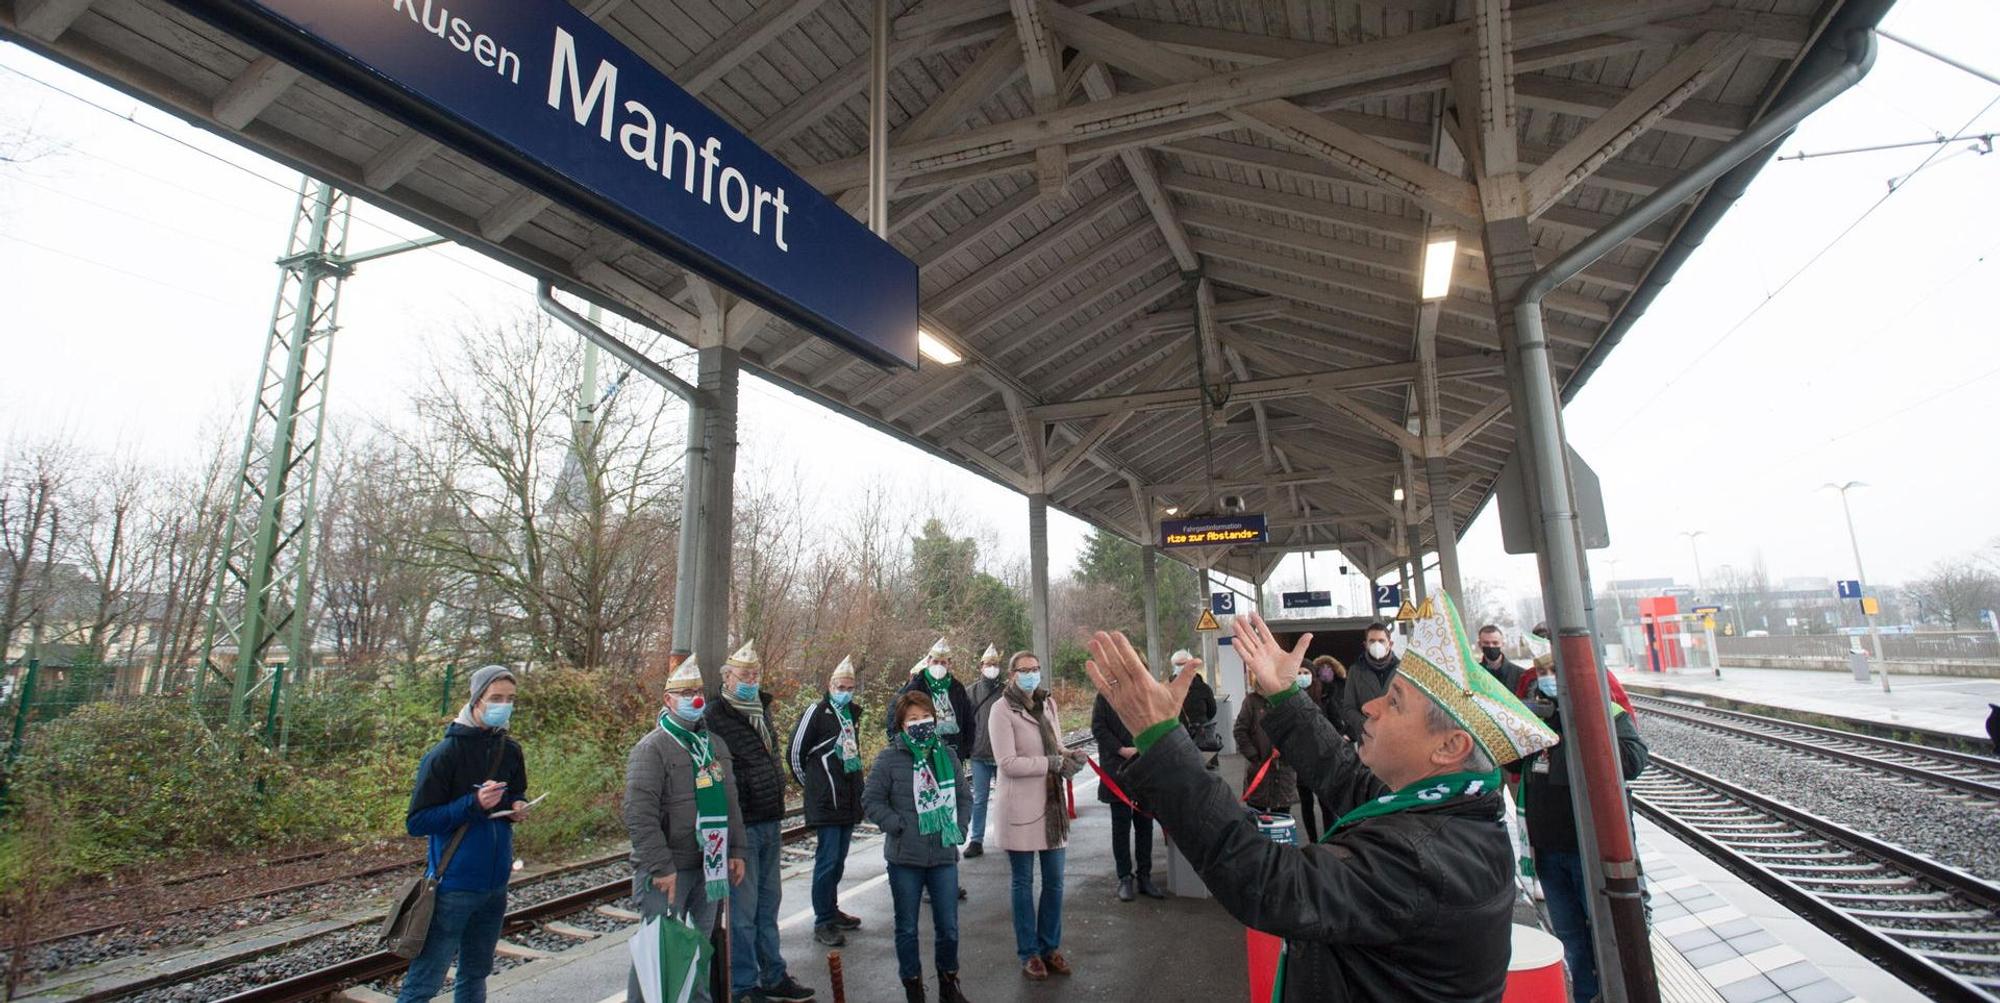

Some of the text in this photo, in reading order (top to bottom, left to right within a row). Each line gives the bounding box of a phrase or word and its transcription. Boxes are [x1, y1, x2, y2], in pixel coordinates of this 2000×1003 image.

[547, 26, 790, 253] Manfort
[1188, 533, 1206, 543] zur
[1206, 529, 1259, 541] Abstands-
[1377, 585, 1391, 603] 2
[1840, 581, 1850, 595] 1
[1220, 593, 1232, 610] 3
